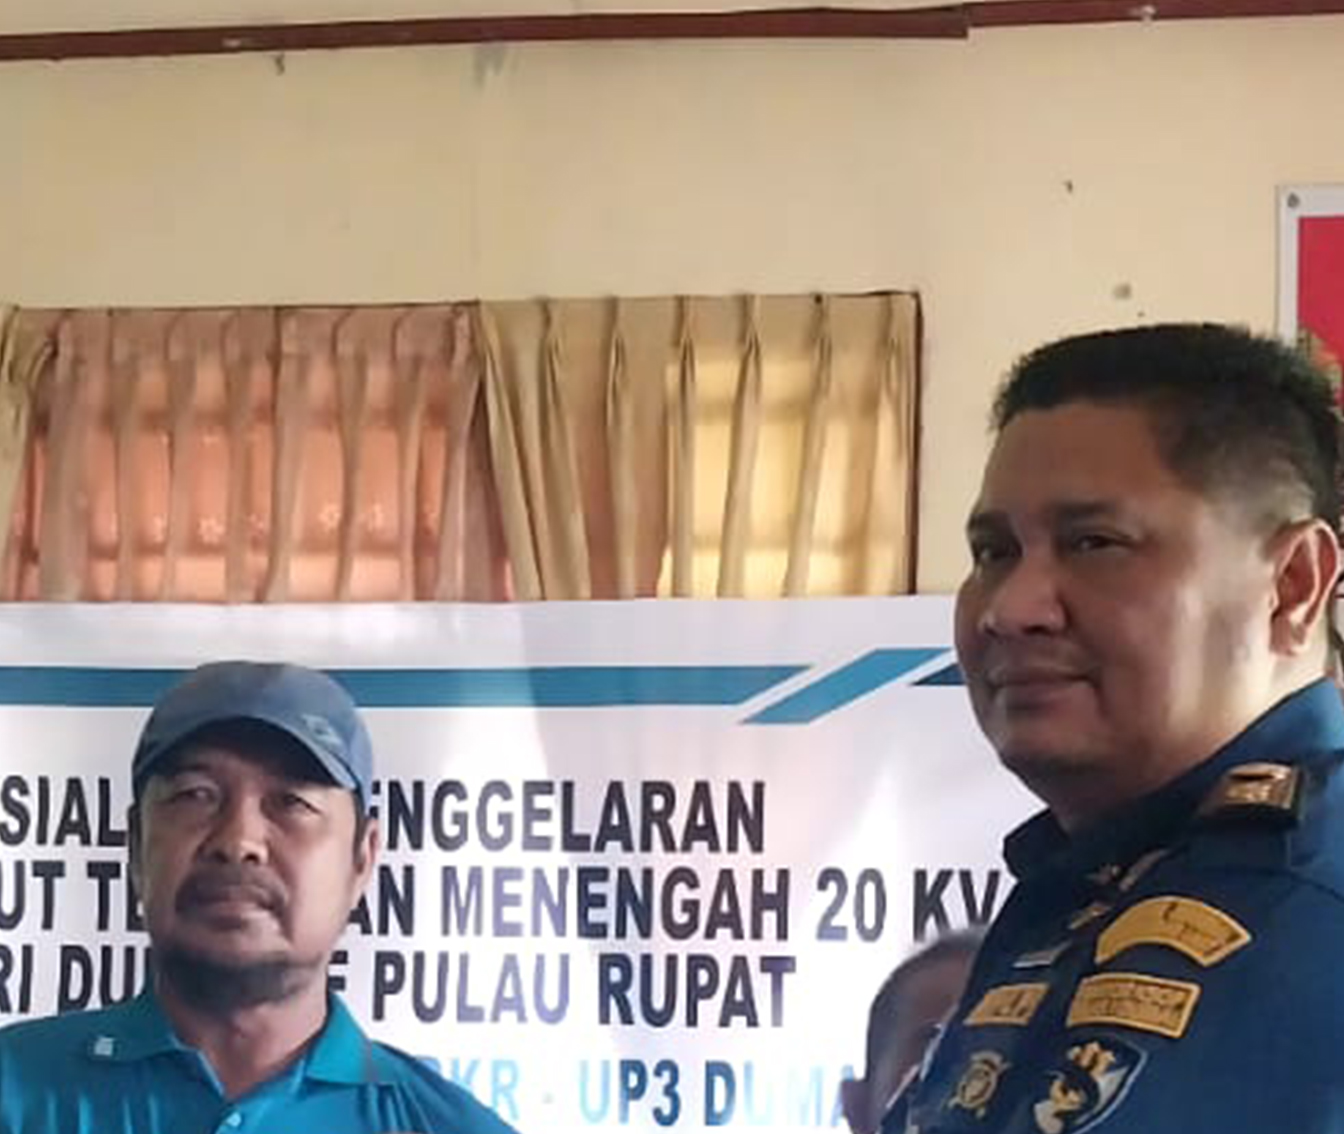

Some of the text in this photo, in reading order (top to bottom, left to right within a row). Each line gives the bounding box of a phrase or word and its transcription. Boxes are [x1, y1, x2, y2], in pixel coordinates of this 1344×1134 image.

[369, 780, 765, 853] NGGELARAN
[441, 865, 790, 941] MENENGAH
[816, 867, 887, 942] 20
[373, 951, 570, 1025] PULAU
[599, 953, 796, 1027] RUPAT
[579, 1059, 681, 1127] UP3
